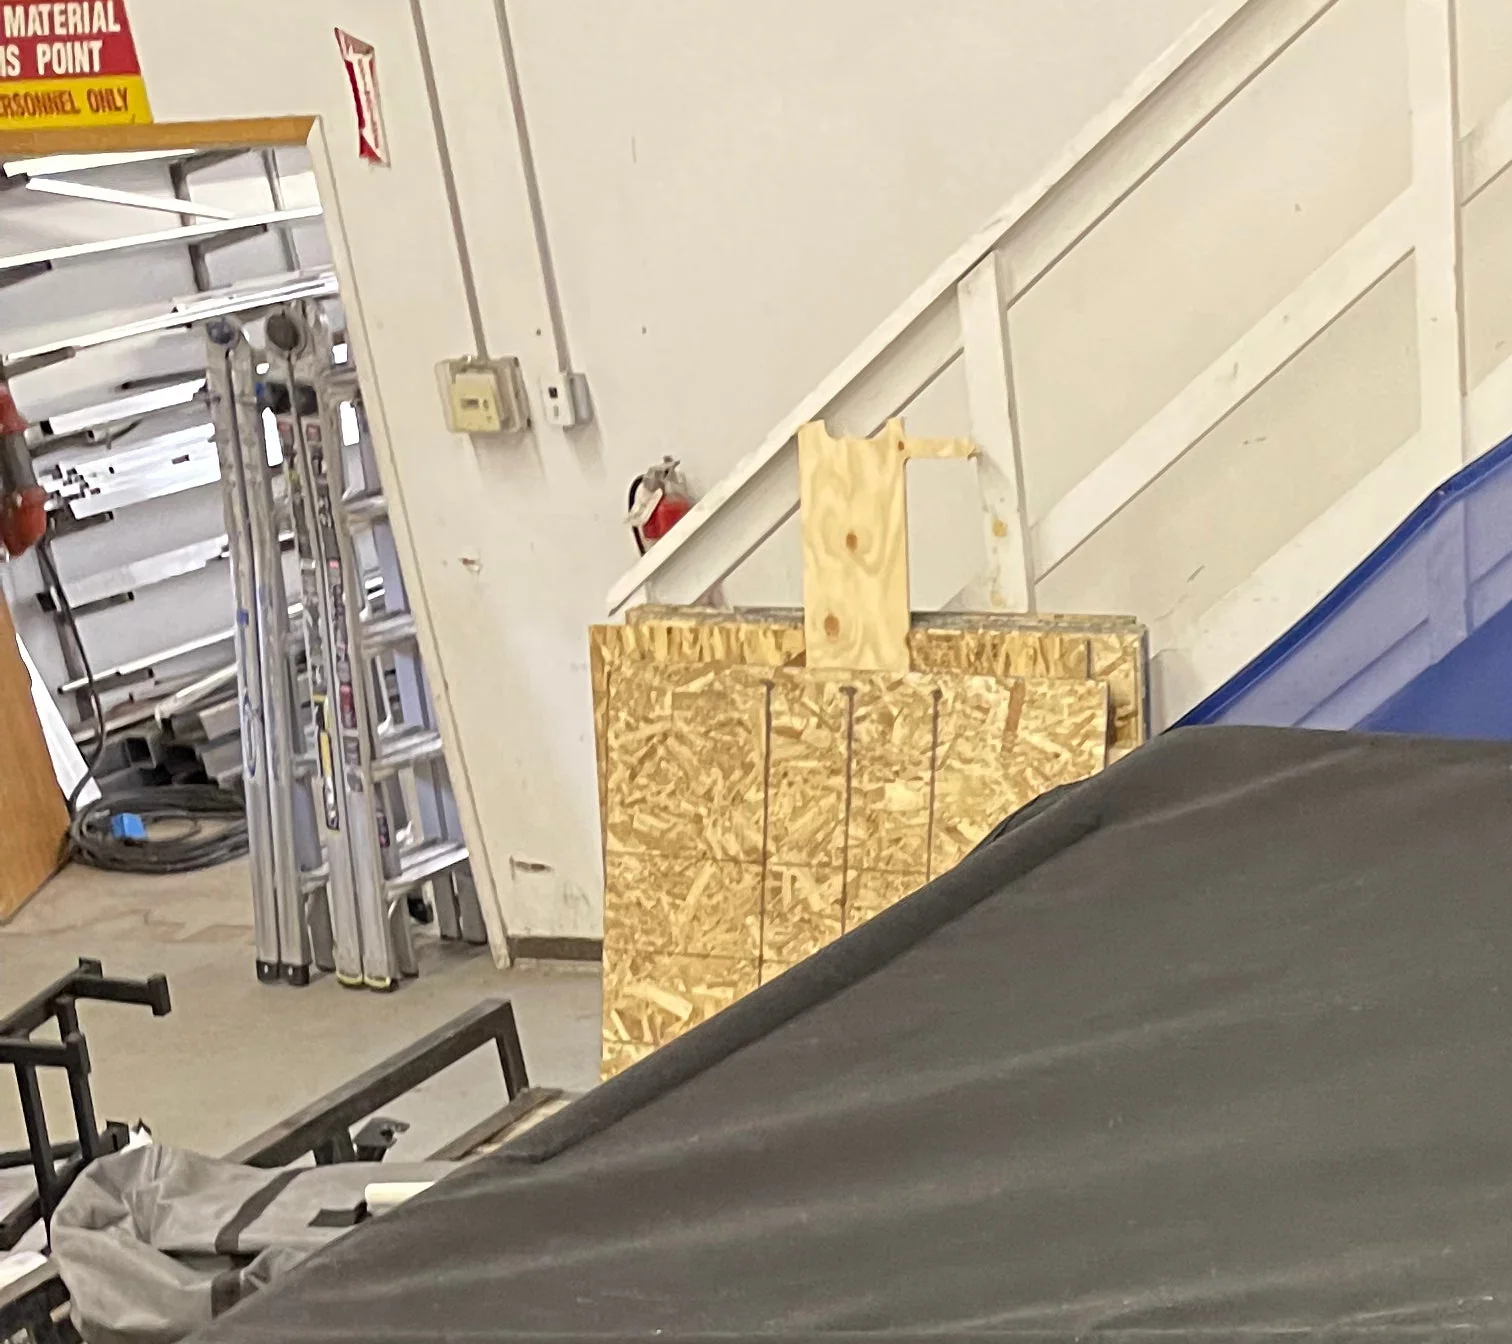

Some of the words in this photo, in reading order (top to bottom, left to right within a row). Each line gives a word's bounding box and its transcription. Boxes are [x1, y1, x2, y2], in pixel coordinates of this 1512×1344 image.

[3, 0, 121, 38] MATERIAL
[36, 40, 103, 75] POINT
[86, 87, 128, 113] ONLY
